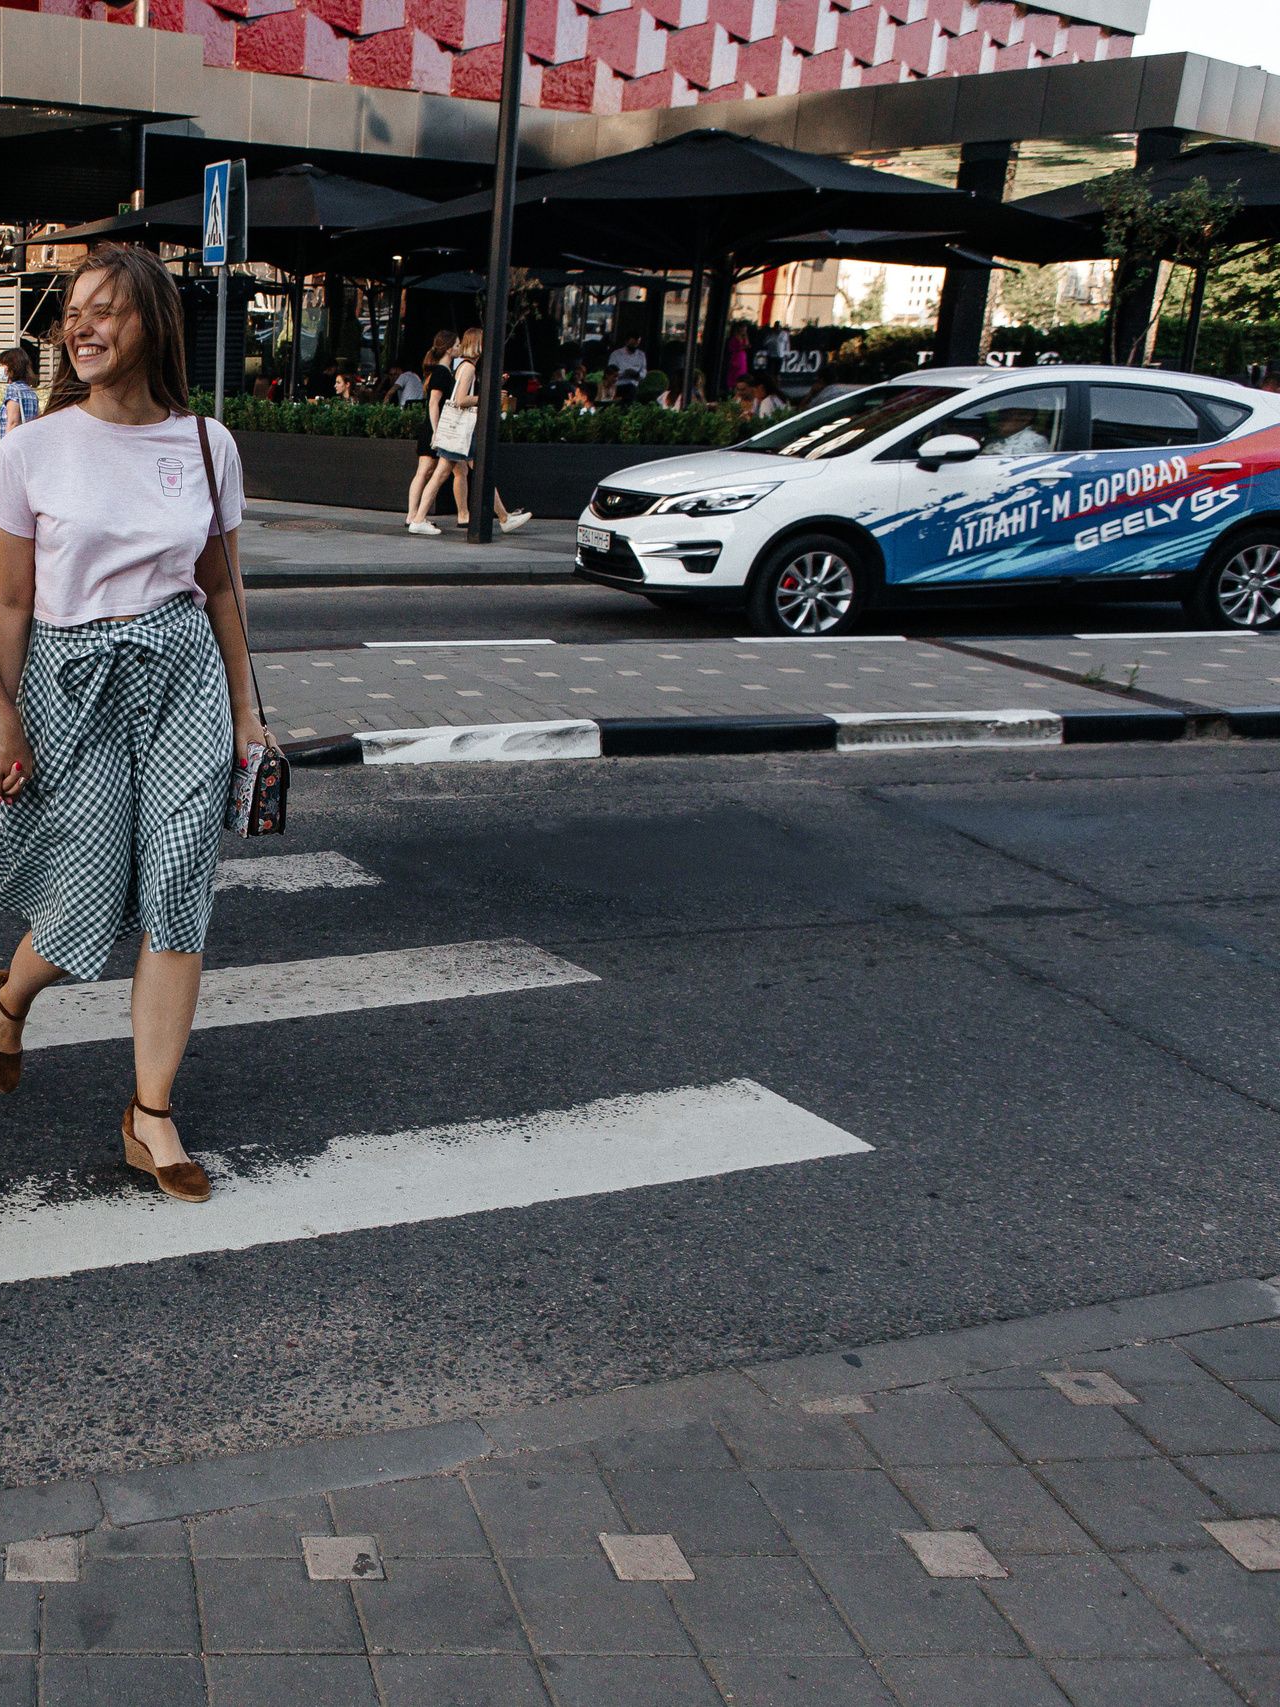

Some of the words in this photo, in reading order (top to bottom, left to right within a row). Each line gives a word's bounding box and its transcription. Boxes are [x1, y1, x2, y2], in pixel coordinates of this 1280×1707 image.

[947, 489, 1071, 556] АТЛАНТ-М
[1078, 455, 1188, 513] БОРОВАЯ
[1074, 496, 1186, 552] GEELY
